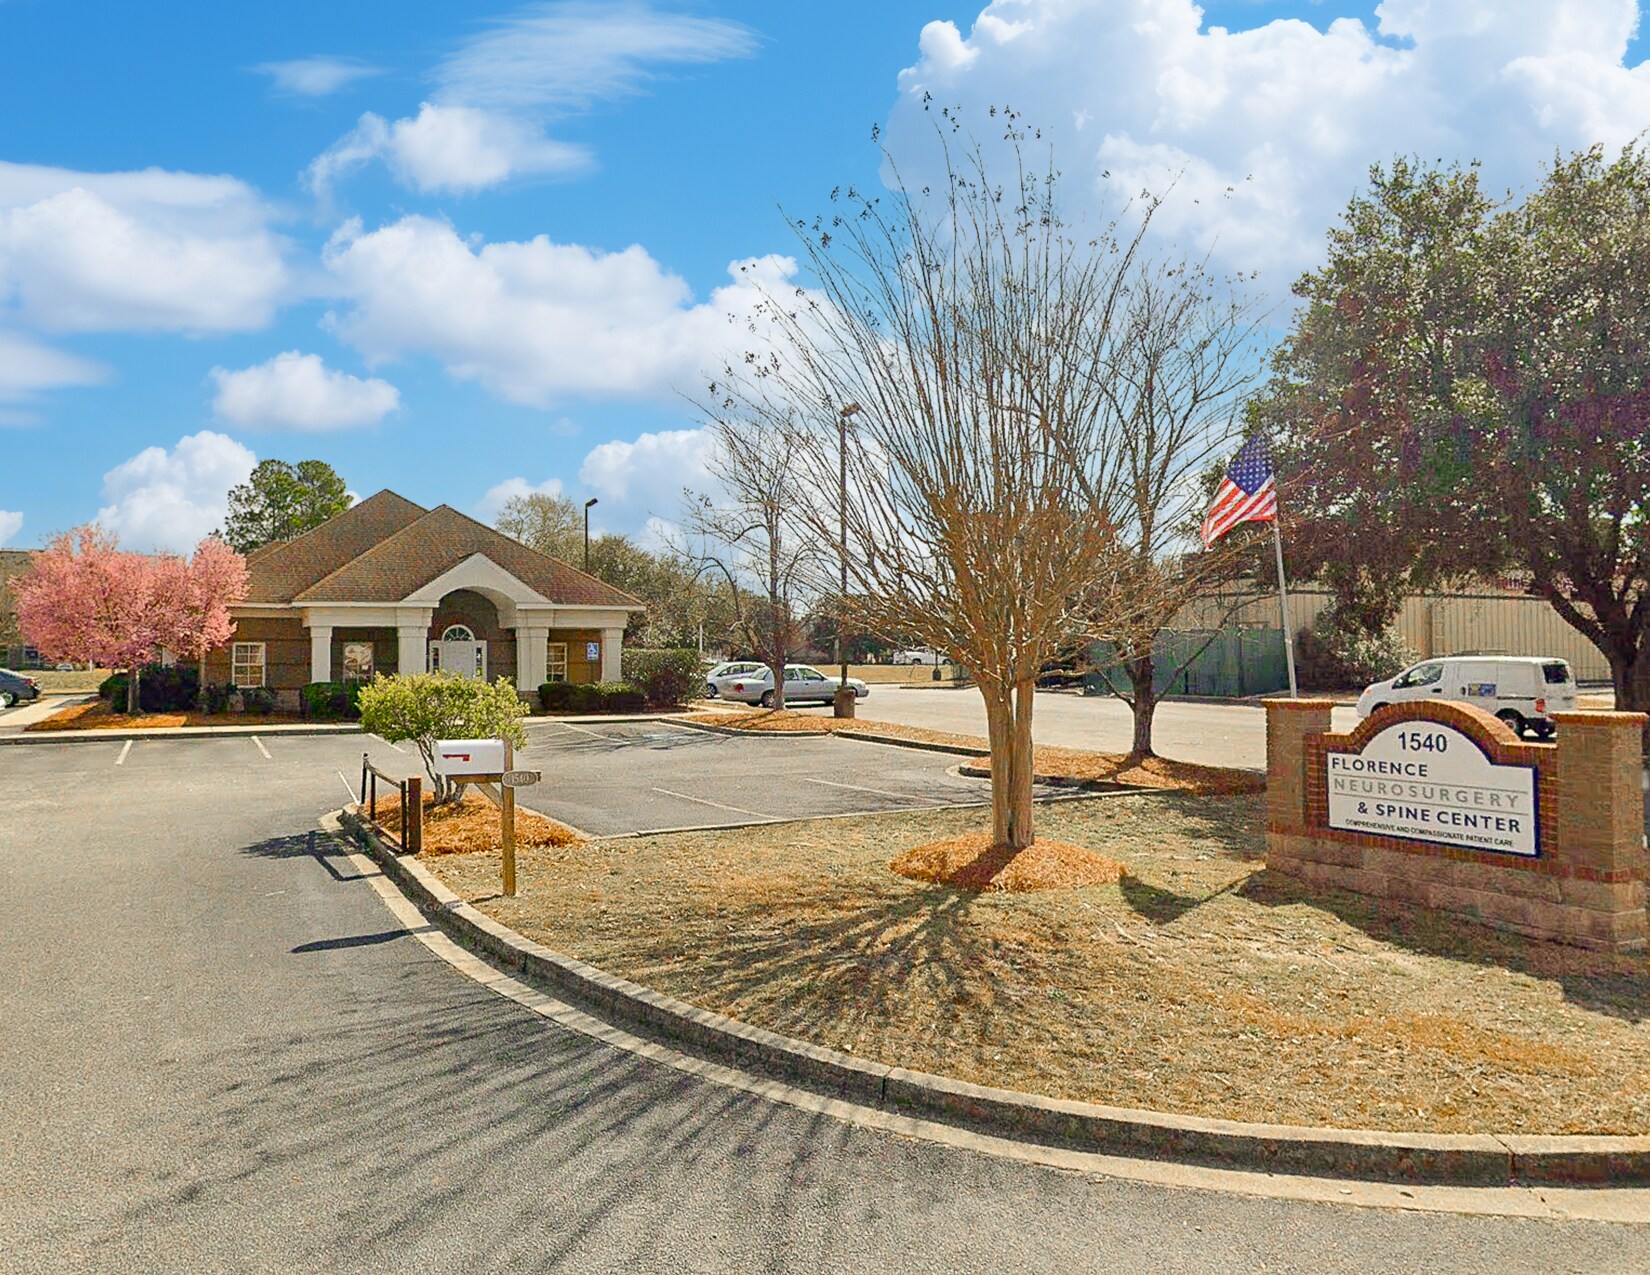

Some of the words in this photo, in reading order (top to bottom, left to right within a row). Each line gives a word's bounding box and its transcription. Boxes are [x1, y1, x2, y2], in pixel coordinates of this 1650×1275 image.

[1398, 732, 1447, 752] 1540
[1332, 757, 1428, 777] FLORENCE
[1334, 778, 1519, 808] NEUROSURGERY
[1357, 801, 1368, 815] &
[1376, 801, 1430, 822] SPINE
[1437, 810, 1521, 833] CENTER
[1345, 818, 1395, 832] COMPREHENSIVE
[1396, 825, 1410, 834] AND
[1410, 826, 1464, 841] COMPASSIONATE
[1465, 834, 1493, 844] PATIENT
[1494, 838, 1514, 848] CARE
